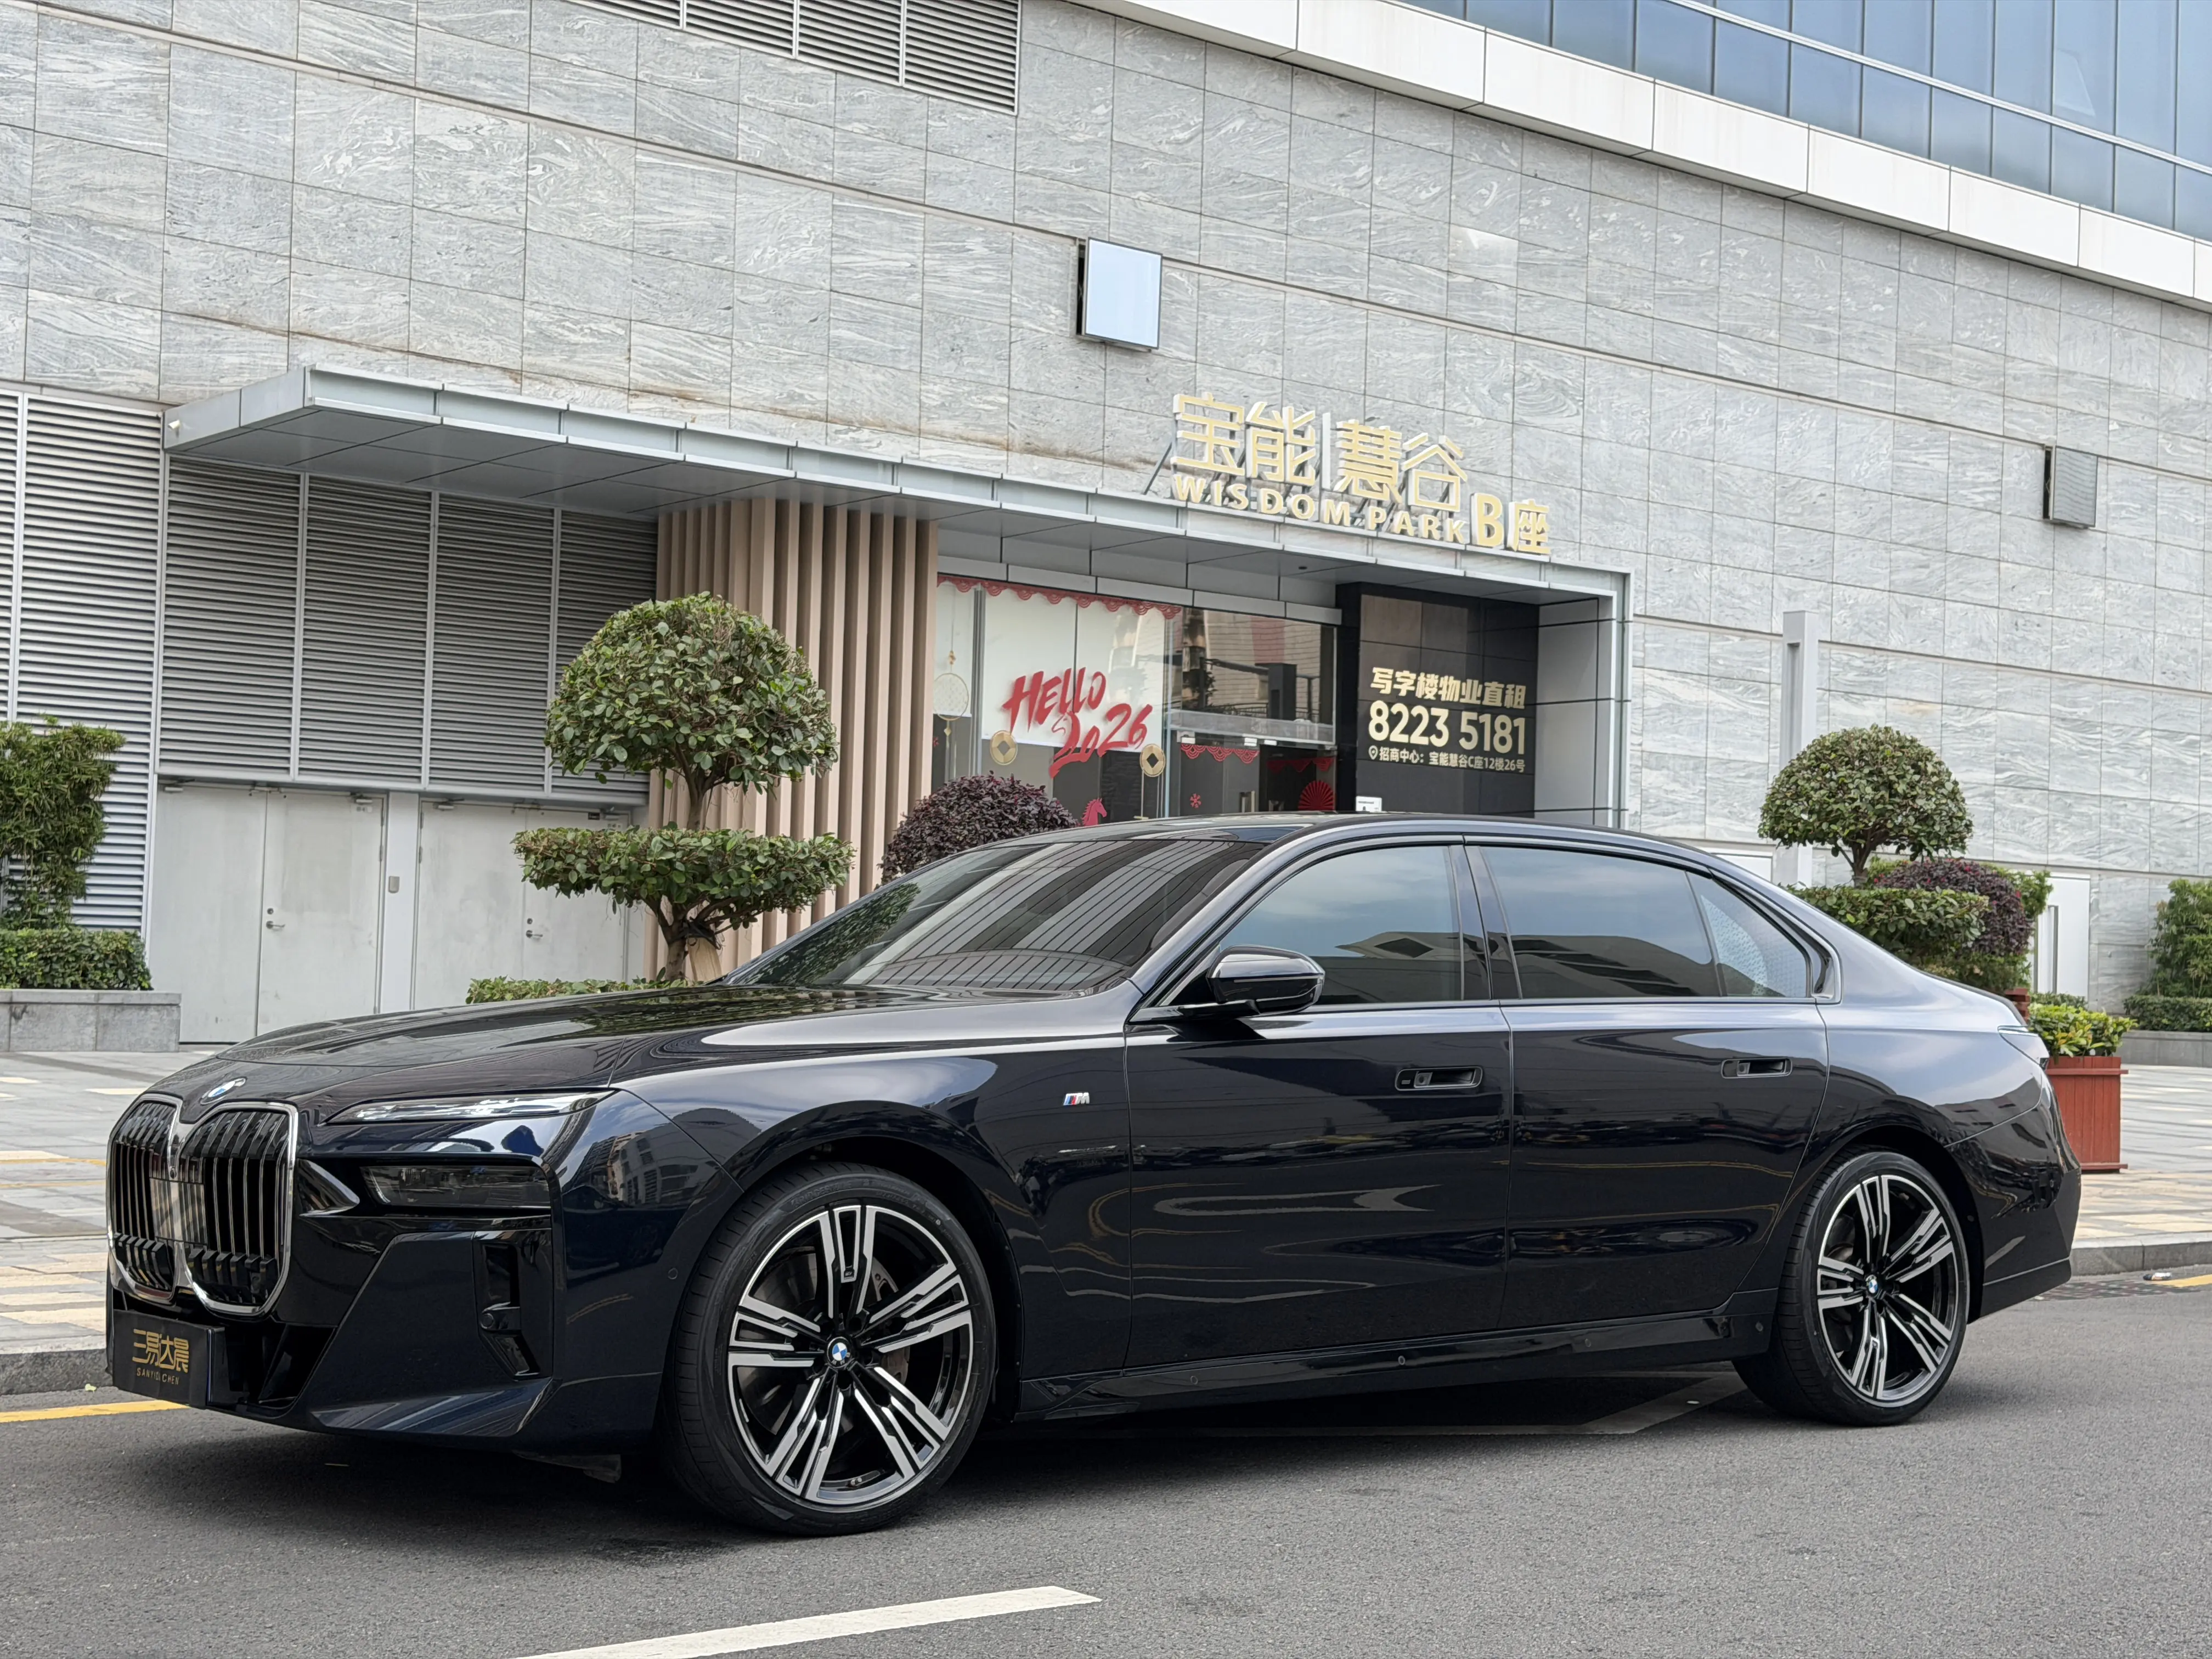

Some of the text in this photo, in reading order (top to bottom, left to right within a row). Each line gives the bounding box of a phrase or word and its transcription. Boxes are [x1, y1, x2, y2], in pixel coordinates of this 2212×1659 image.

[1172, 474, 1468, 544] WISDOM PARK
[1471, 492, 1550, 554] B座
[1002, 667, 1107, 733] HELLO
[1370, 667, 1526, 709] 写字楼物业直租
[1048, 703, 1153, 779] 2026
[1368, 700, 1525, 754] 8223 5181
[162, 1373, 179, 1385] CHEN
